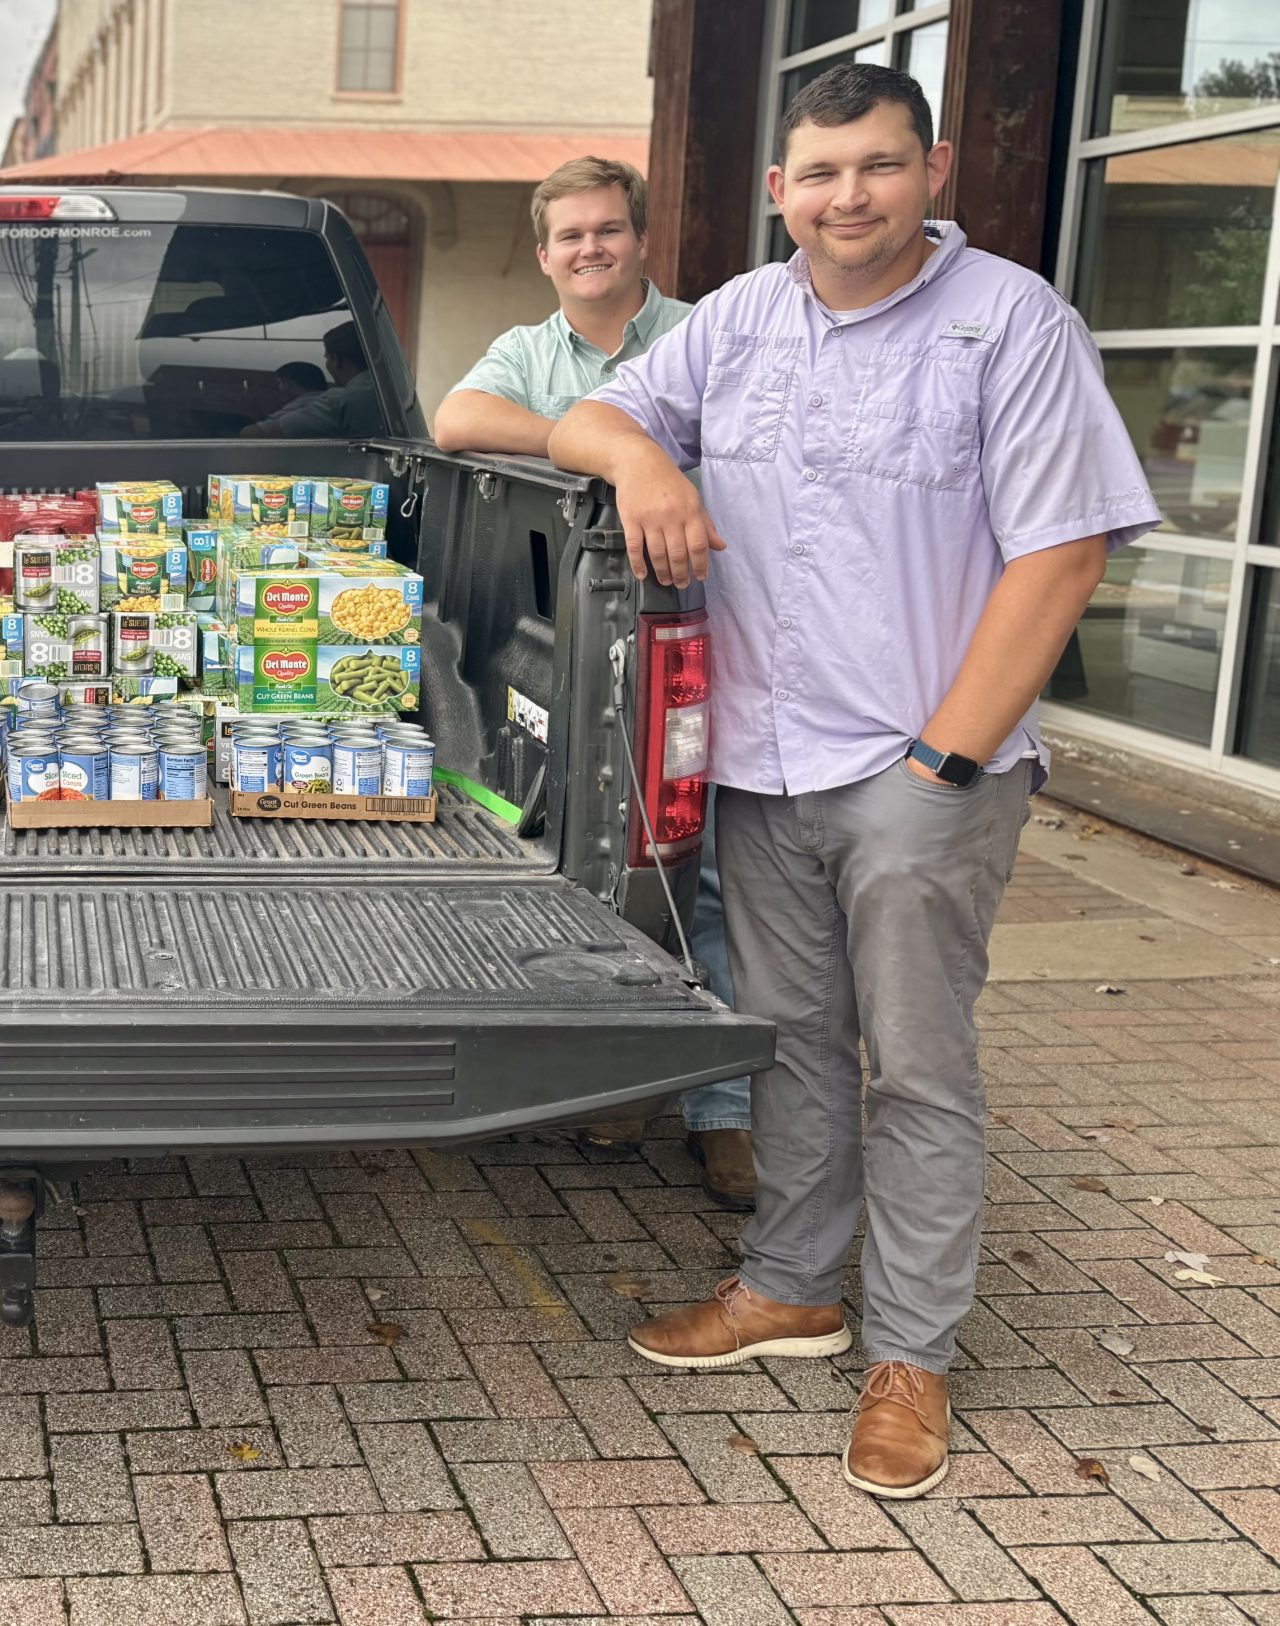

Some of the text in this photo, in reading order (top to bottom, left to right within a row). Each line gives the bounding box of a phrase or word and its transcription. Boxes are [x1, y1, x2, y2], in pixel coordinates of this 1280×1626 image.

[298, 486, 305, 496] 8
[376, 490, 384, 498] 8
[167, 497, 176, 508] 8
[194, 538, 204, 546] 8
[374, 544, 381, 554] 8
[30, 554, 50, 564] SUEUR
[172, 553, 181, 564] 8
[76, 564, 94, 585] 8
[409, 582, 418, 594] 8
[76, 590, 94, 598] CANS
[266, 592, 308, 601] Del Monte
[8, 619, 16, 630] 8
[128, 618, 148, 627] SUEUR
[30, 630, 48, 638] CANS
[174, 628, 192, 649] 8
[30, 643, 48, 662] 8
[173, 652, 192, 660] CANS
[406, 650, 416, 662] 8
[266, 660, 307, 669] Del Monte
[283, 800, 356, 810] Cut Green Beans
